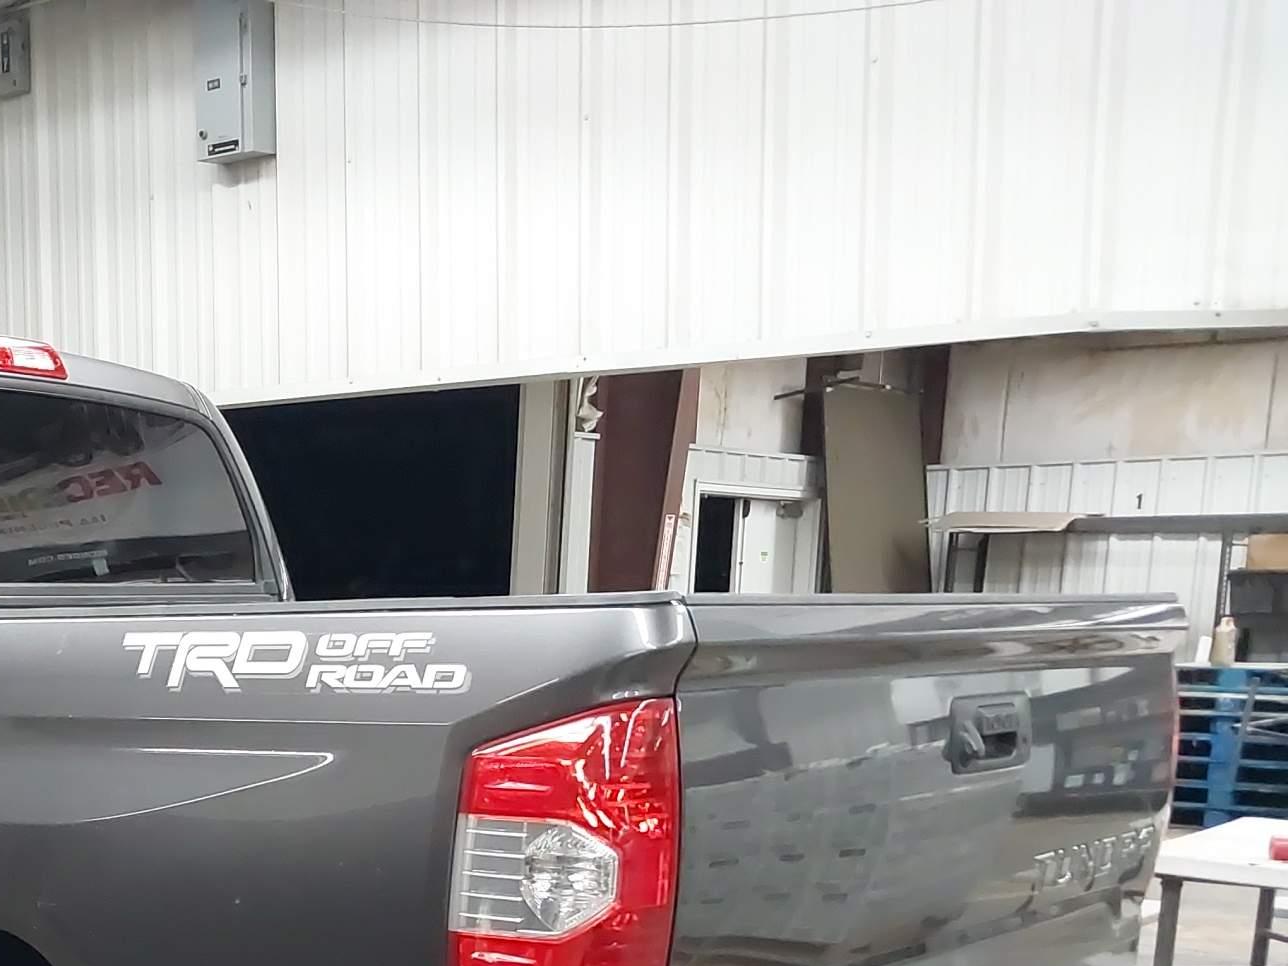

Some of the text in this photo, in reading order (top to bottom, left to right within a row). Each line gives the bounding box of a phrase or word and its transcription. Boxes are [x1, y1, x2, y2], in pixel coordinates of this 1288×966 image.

[122, 631, 309, 693] TRD
[315, 633, 436, 661] OFF
[305, 664, 472, 694] ROAD
